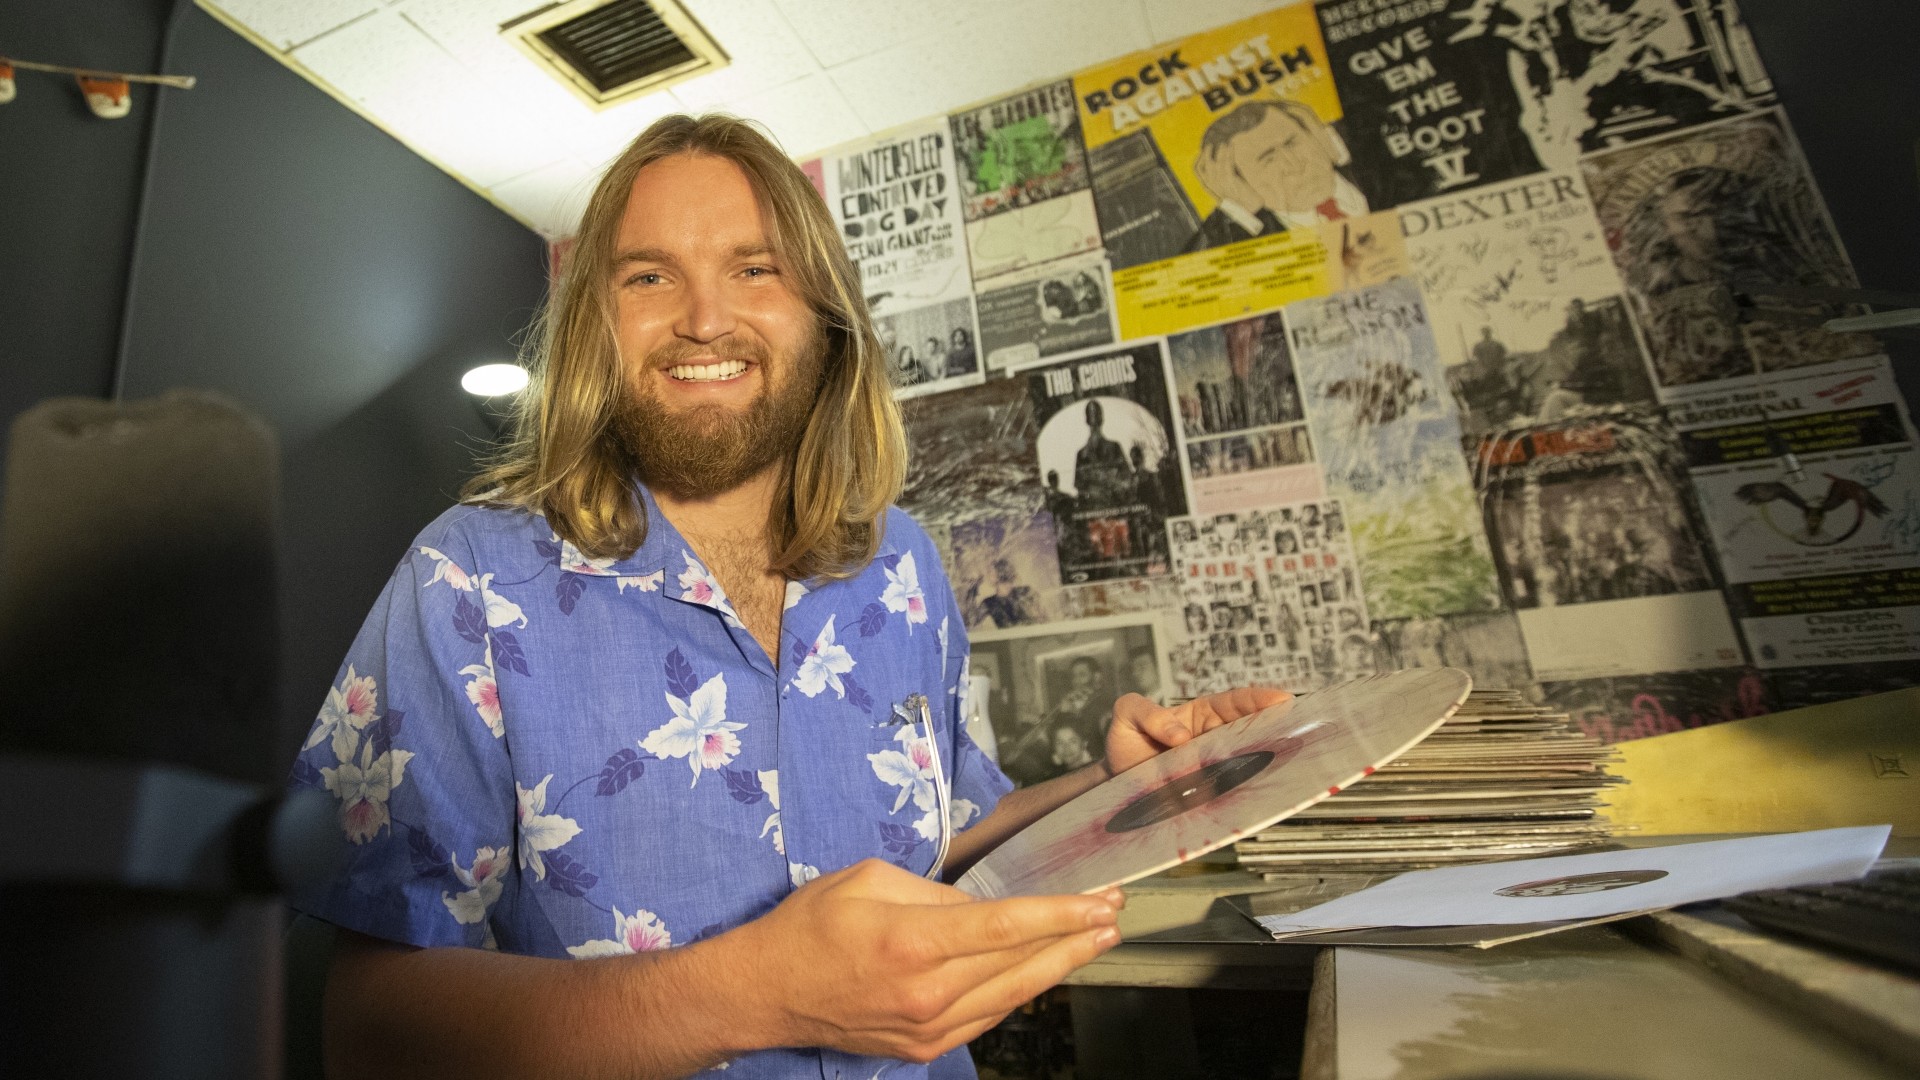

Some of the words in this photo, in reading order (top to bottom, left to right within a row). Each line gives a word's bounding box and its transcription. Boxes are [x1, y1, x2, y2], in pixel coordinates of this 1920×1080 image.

[1349, 26, 1433, 76] GIVE
[1084, 49, 1191, 115] ROCK
[1110, 33, 1273, 132] AGAINST
[1200, 44, 1315, 113] BUSH
[1387, 81, 1463, 125] THE
[1386, 107, 1487, 159] BOOT
[838, 132, 944, 194] WINTERSLEEP
[1422, 147, 1481, 191] V
[840, 171, 947, 220] CONTRIVED
[844, 211, 896, 239] DOG
[903, 197, 948, 226] DAY
[1399, 174, 1586, 239] DEXTER
[887, 225, 933, 252] GRANT
